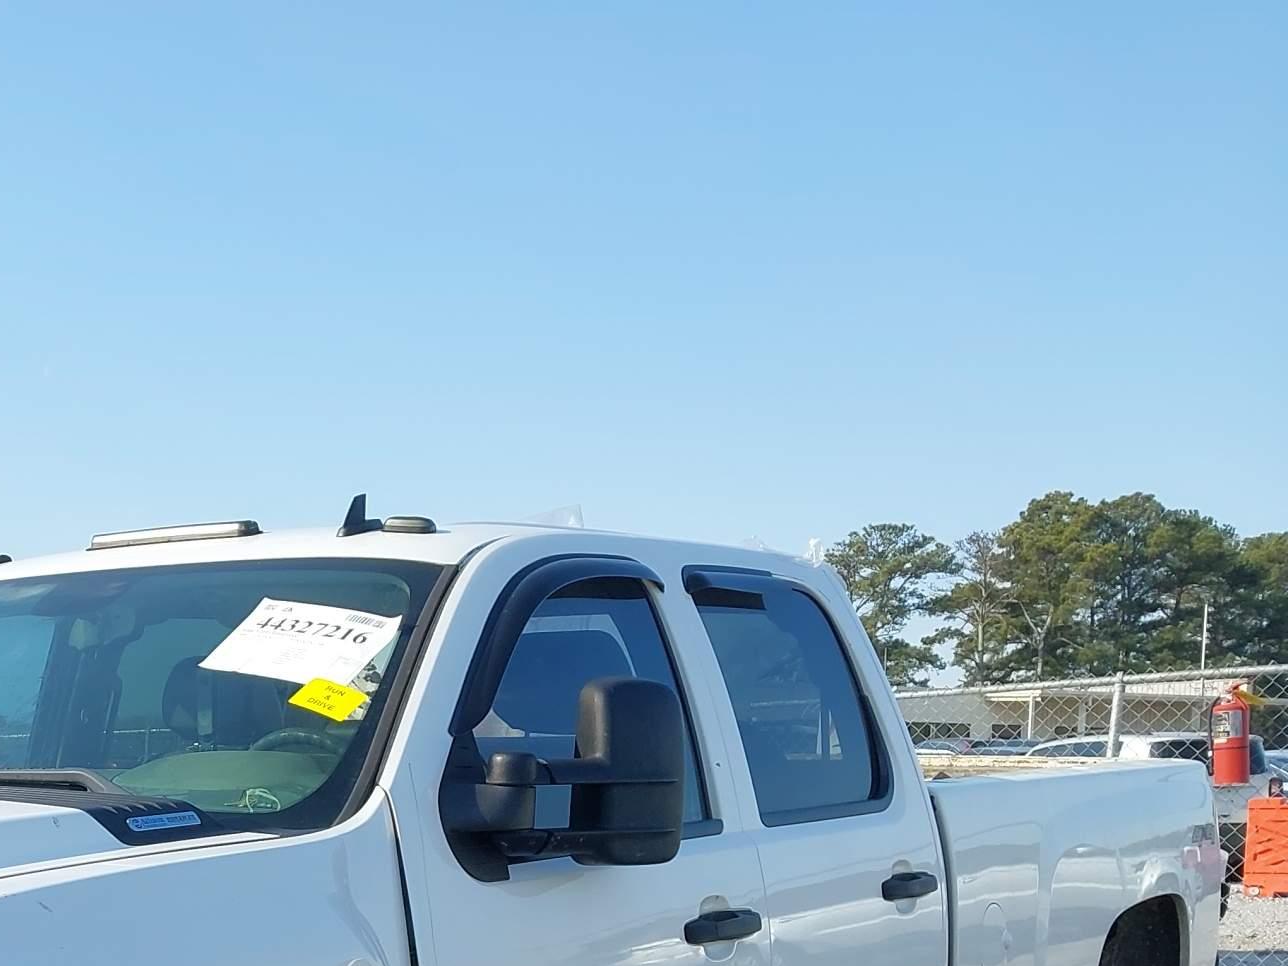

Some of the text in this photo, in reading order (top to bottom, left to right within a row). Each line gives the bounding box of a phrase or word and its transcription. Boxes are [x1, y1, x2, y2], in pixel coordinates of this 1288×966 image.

[256, 616, 371, 645] 44327216
[324, 685, 346, 697] RUN
[307, 697, 336, 711] DRIVE
